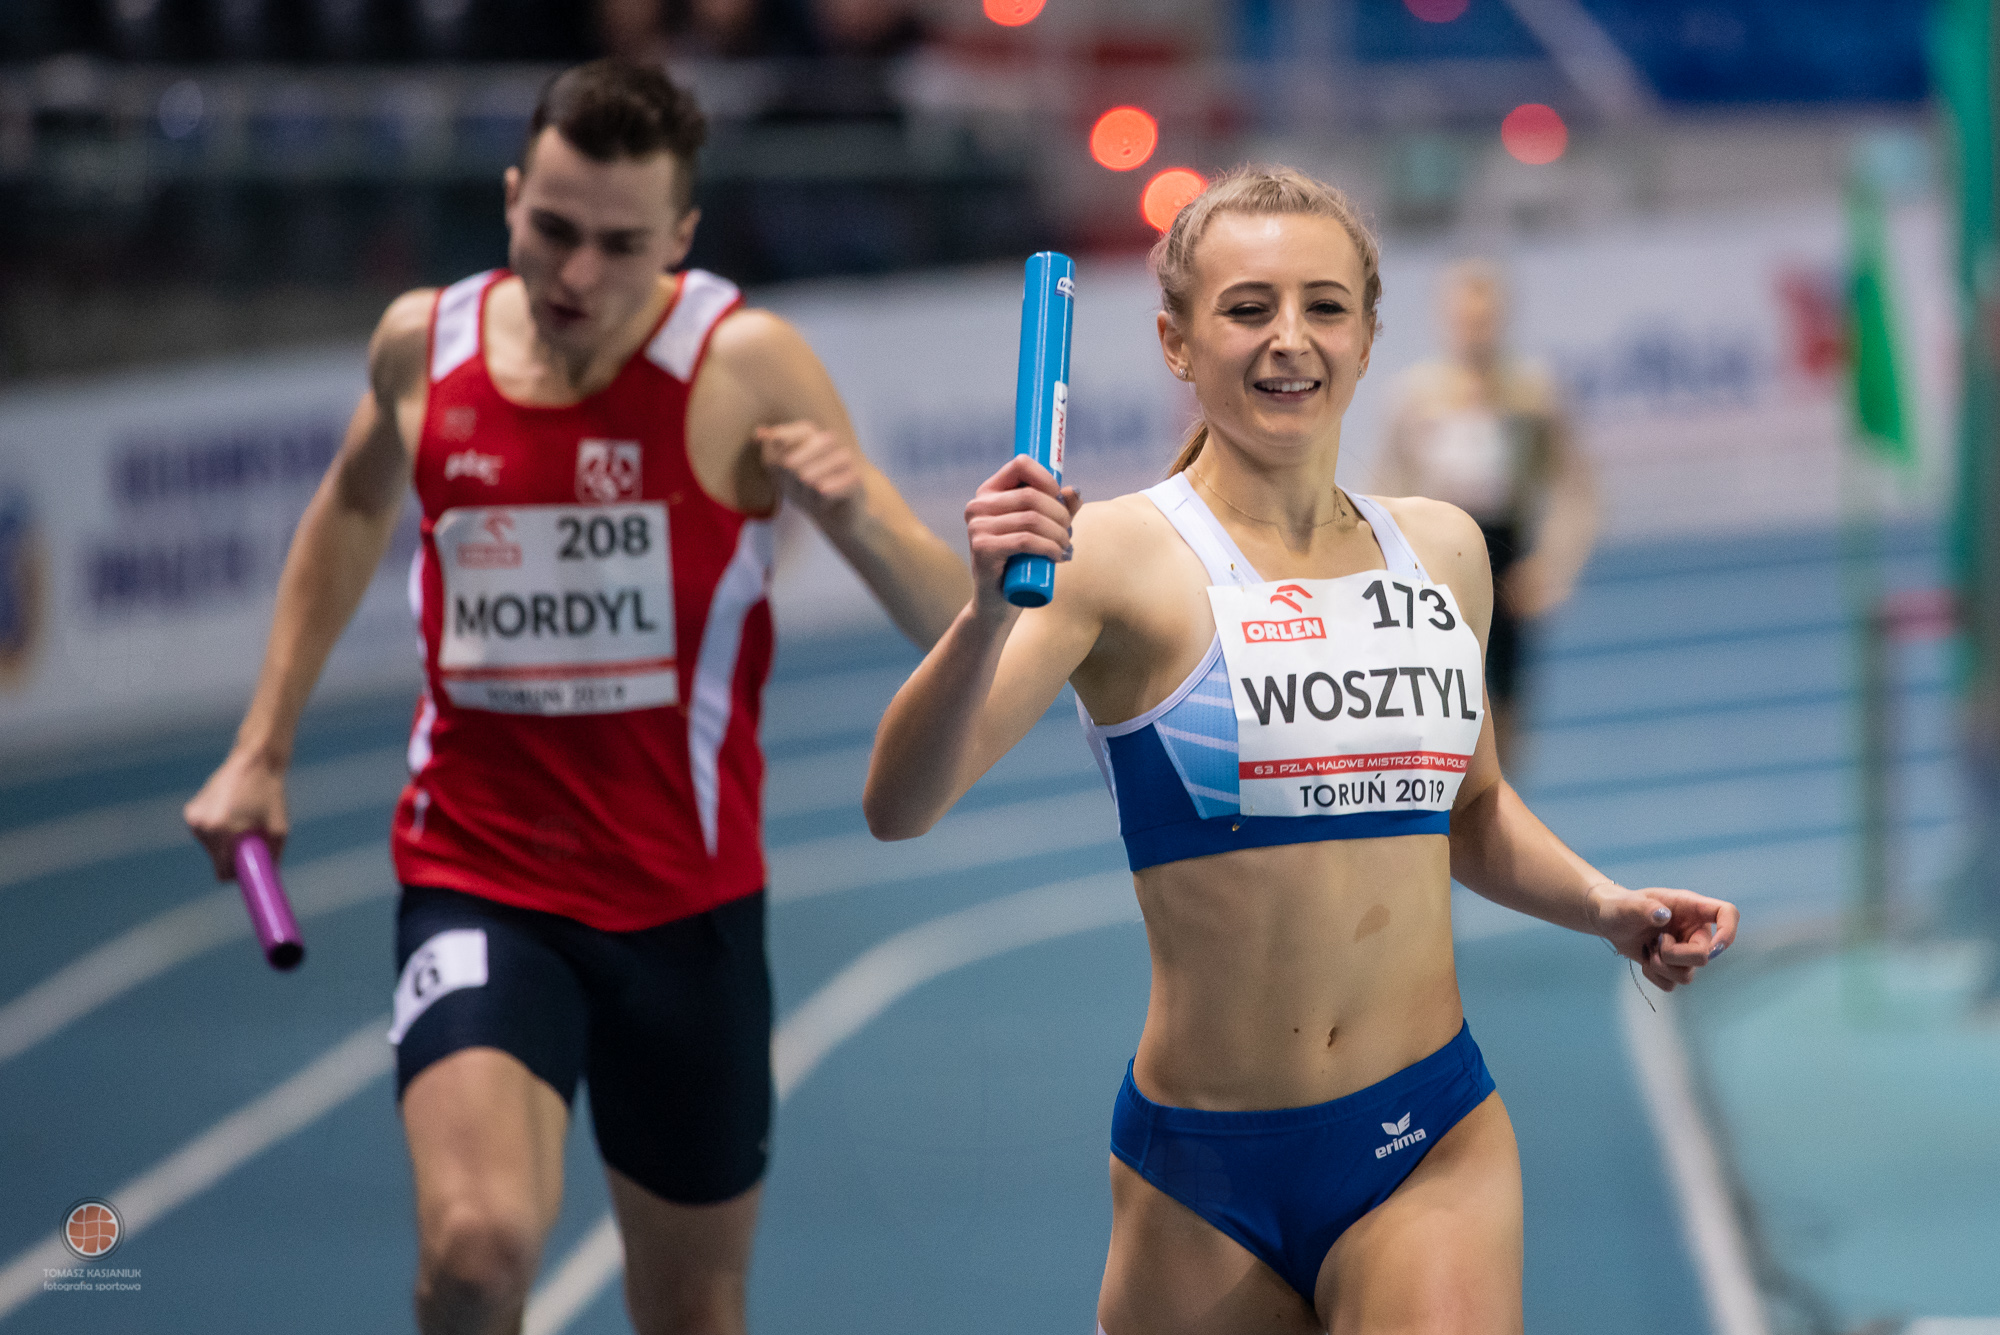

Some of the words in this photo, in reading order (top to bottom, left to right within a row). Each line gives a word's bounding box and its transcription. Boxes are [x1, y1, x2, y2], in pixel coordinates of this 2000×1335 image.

[556, 515, 651, 562] 208
[453, 588, 657, 640] MORDYL
[1361, 580, 1456, 631] 173
[1245, 619, 1324, 642] ORLEN
[1240, 667, 1477, 726] WOSZTYL
[1254, 764, 1277, 775] 63.
[1279, 762, 1315, 773] PZLA
[1316, 758, 1365, 771] HALOWE
[1367, 755, 1446, 768] MISTRZOSTWA
[1300, 773, 1386, 808] TORUŃ
[1395, 779, 1445, 804] 2019
[1374, 1128, 1426, 1159] erima
